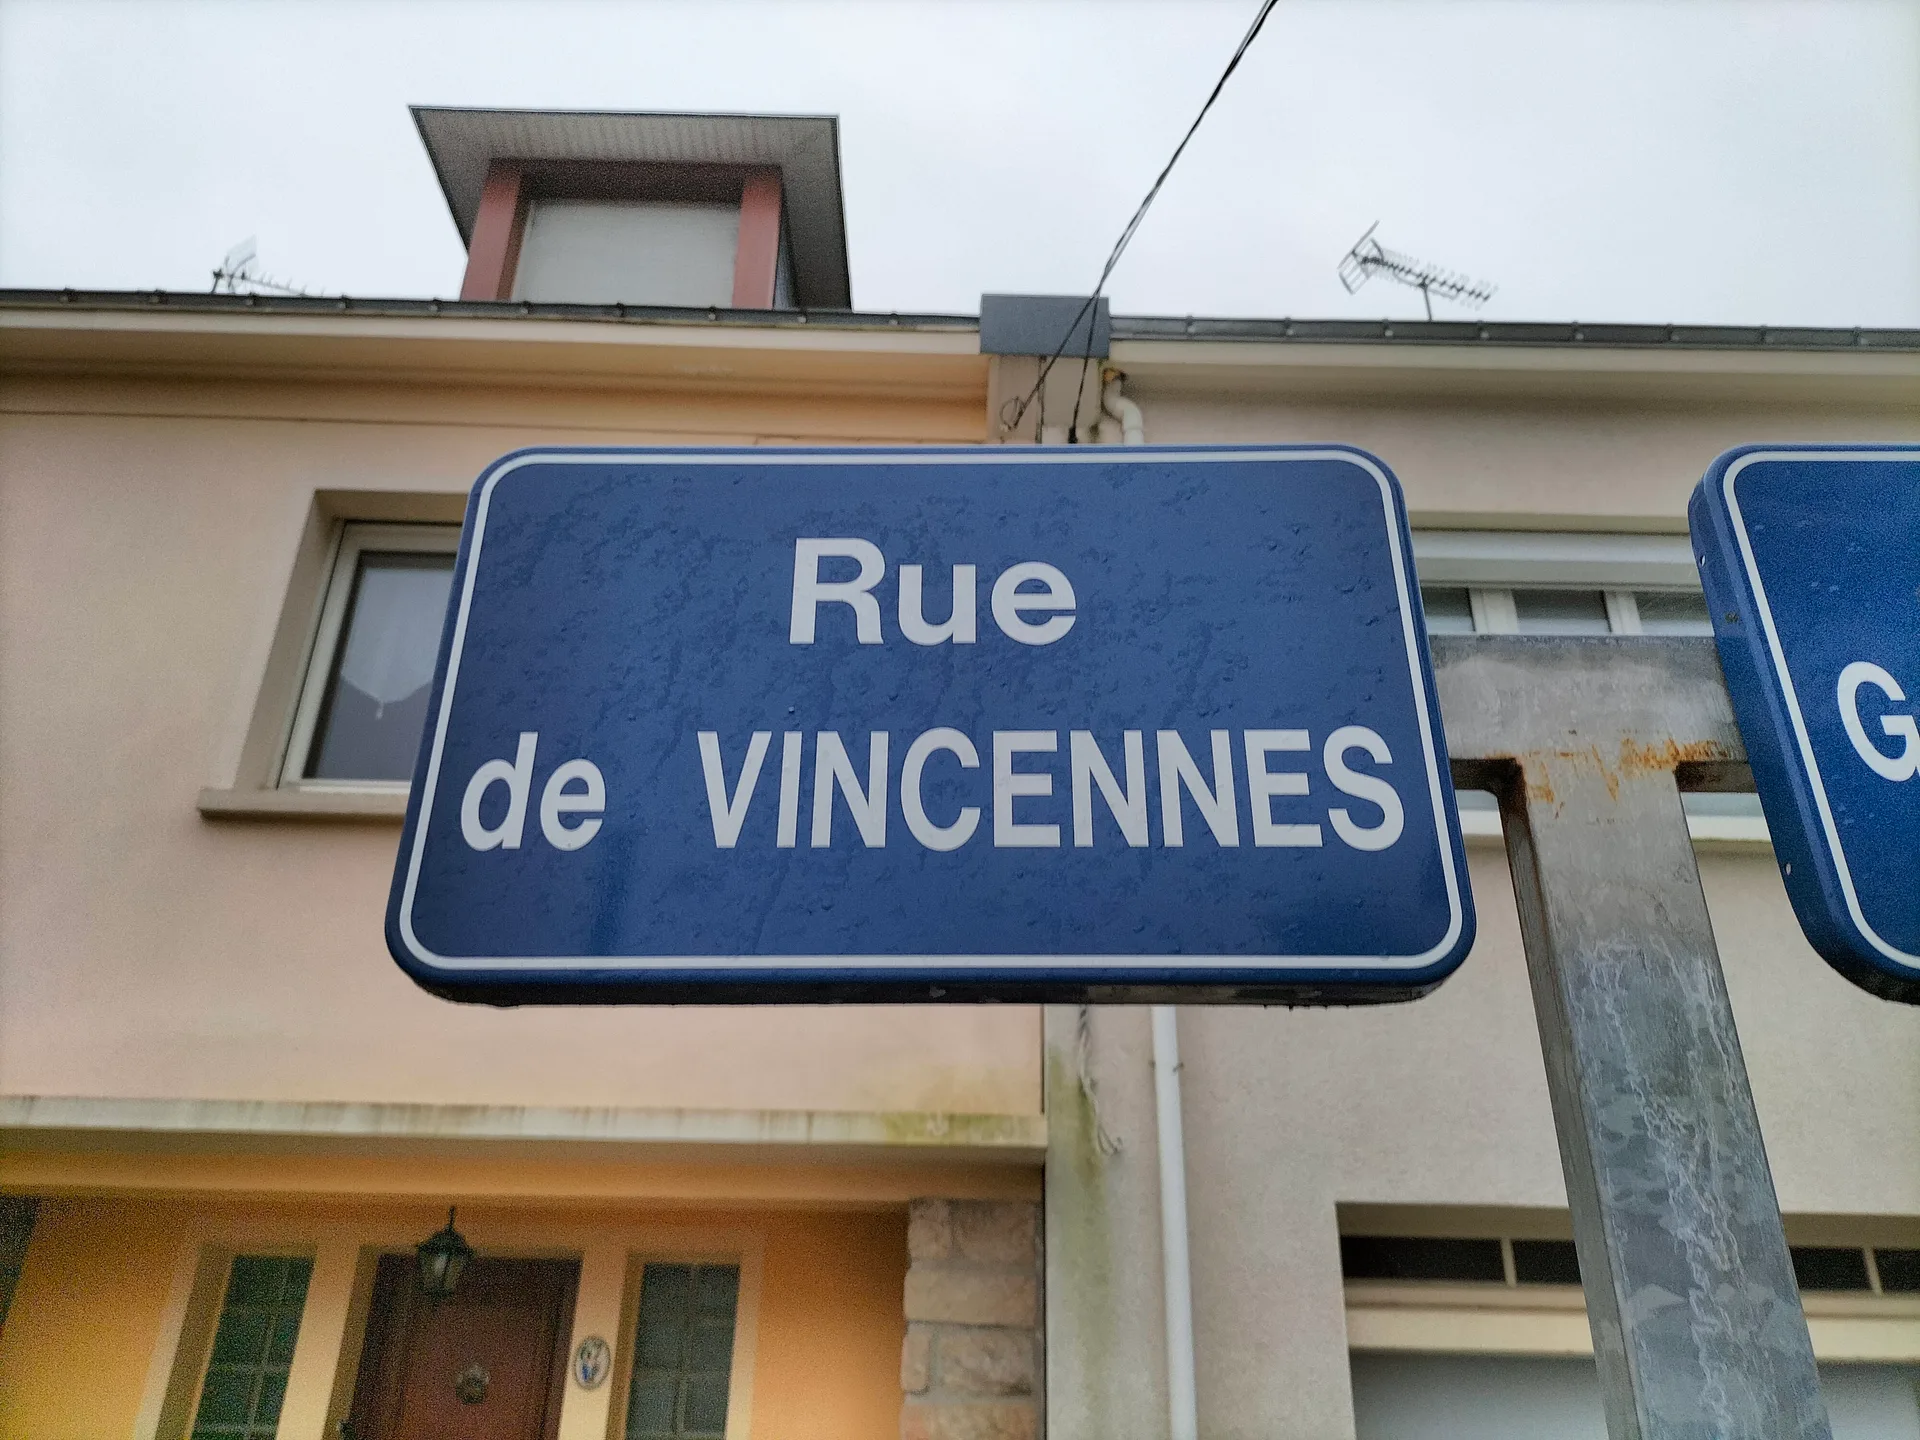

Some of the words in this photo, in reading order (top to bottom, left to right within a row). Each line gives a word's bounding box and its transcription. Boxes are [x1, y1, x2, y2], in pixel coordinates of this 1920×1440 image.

[789, 537, 1077, 646] Rue
[460, 731, 607, 852] de
[697, 725, 1405, 852] VINCENNES
